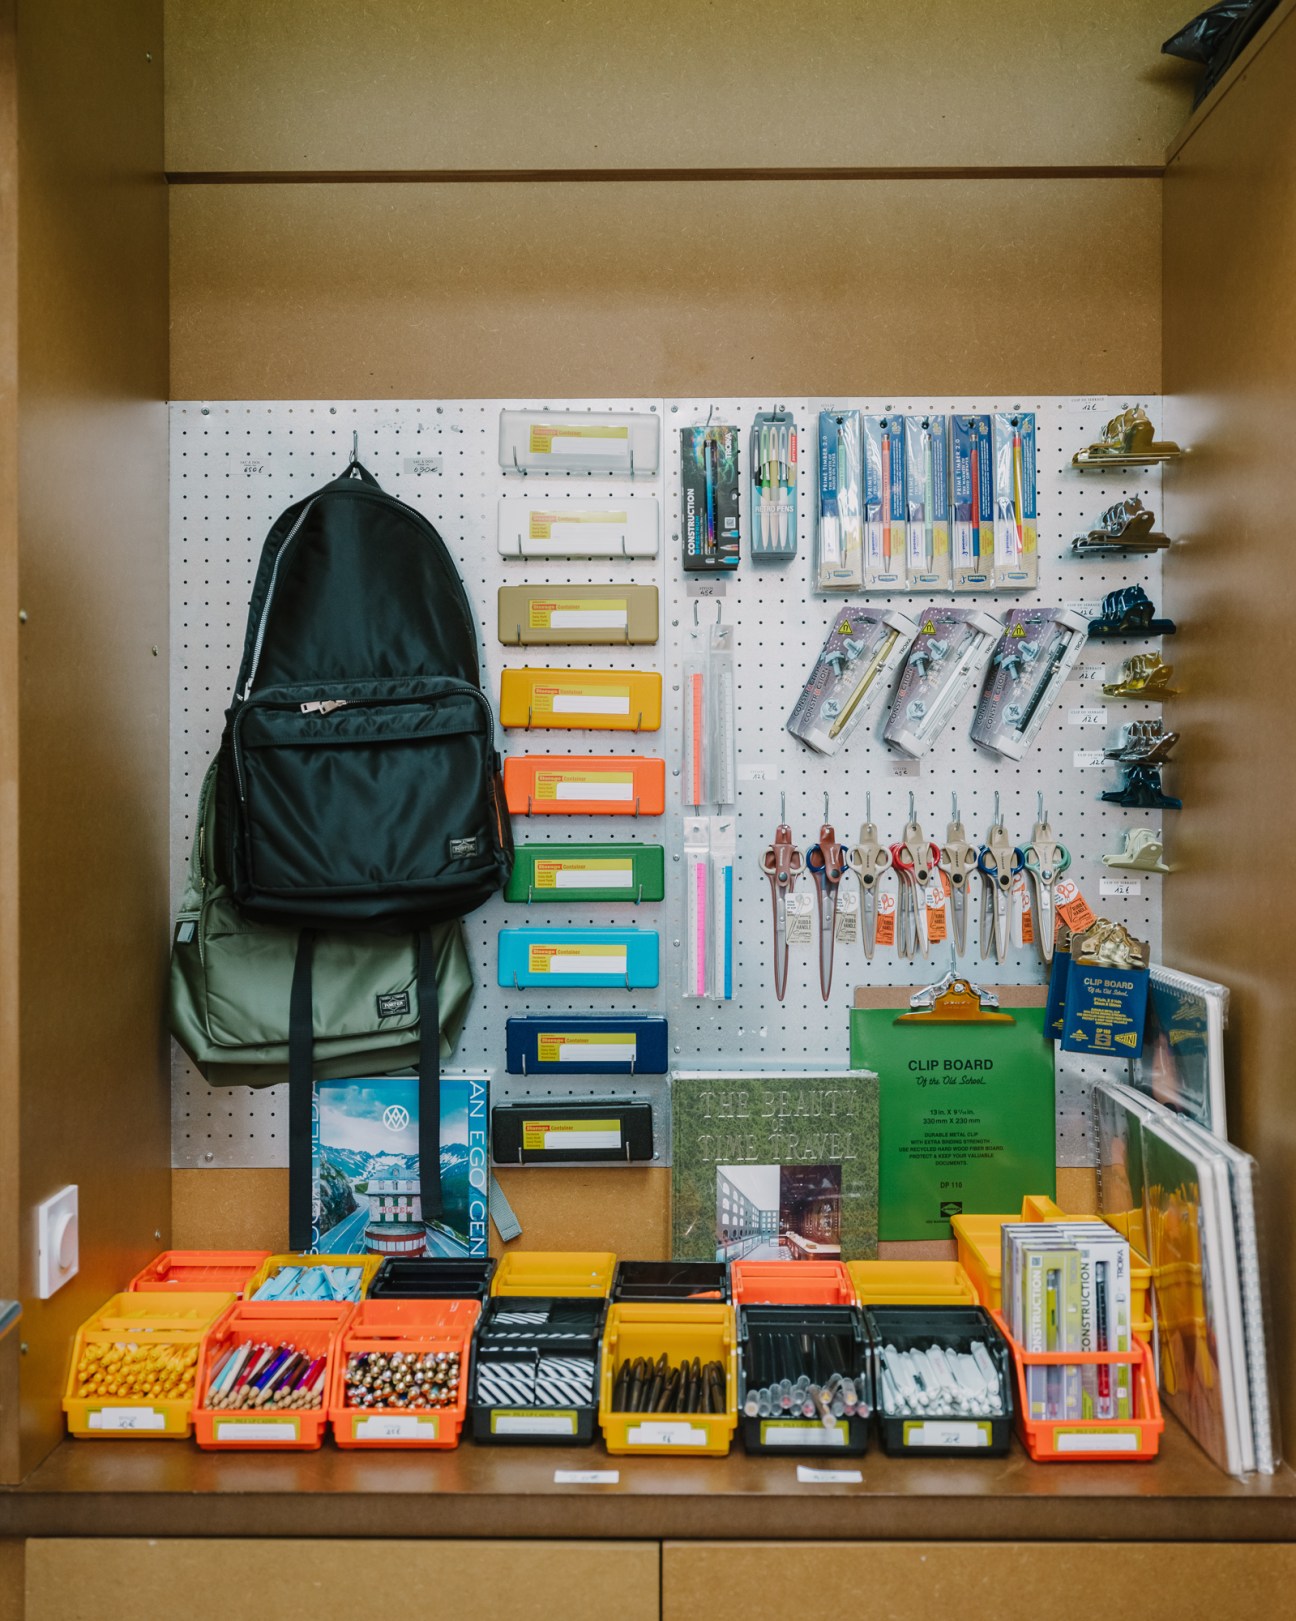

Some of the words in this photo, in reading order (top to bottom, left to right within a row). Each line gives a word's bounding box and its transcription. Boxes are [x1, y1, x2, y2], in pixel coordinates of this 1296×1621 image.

[1084, 978, 1102, 986] CLIP
[1104, 980, 1133, 990] BOARD
[908, 1060, 939, 1071] CLIP
[943, 1059, 993, 1070] BOARD
[916, 1076, 927, 1087] Of
[929, 1077, 940, 1085] the
[943, 1076, 957, 1085] Old
[470, 1081, 484, 1118] AN
[698, 1092, 750, 1118] THE
[761, 1090, 857, 1118] BEAUTY
[771, 1118, 784, 1132] OF
[469, 1131, 484, 1188] EGO
[698, 1134, 759, 1161] TIME
[768, 1133, 857, 1160] TRAVEL
[381, 1205, 413, 1214] HOTEL
[470, 1200, 484, 1257] CEN
[1032, 1269, 1041, 1352] ONSTRUCTION
